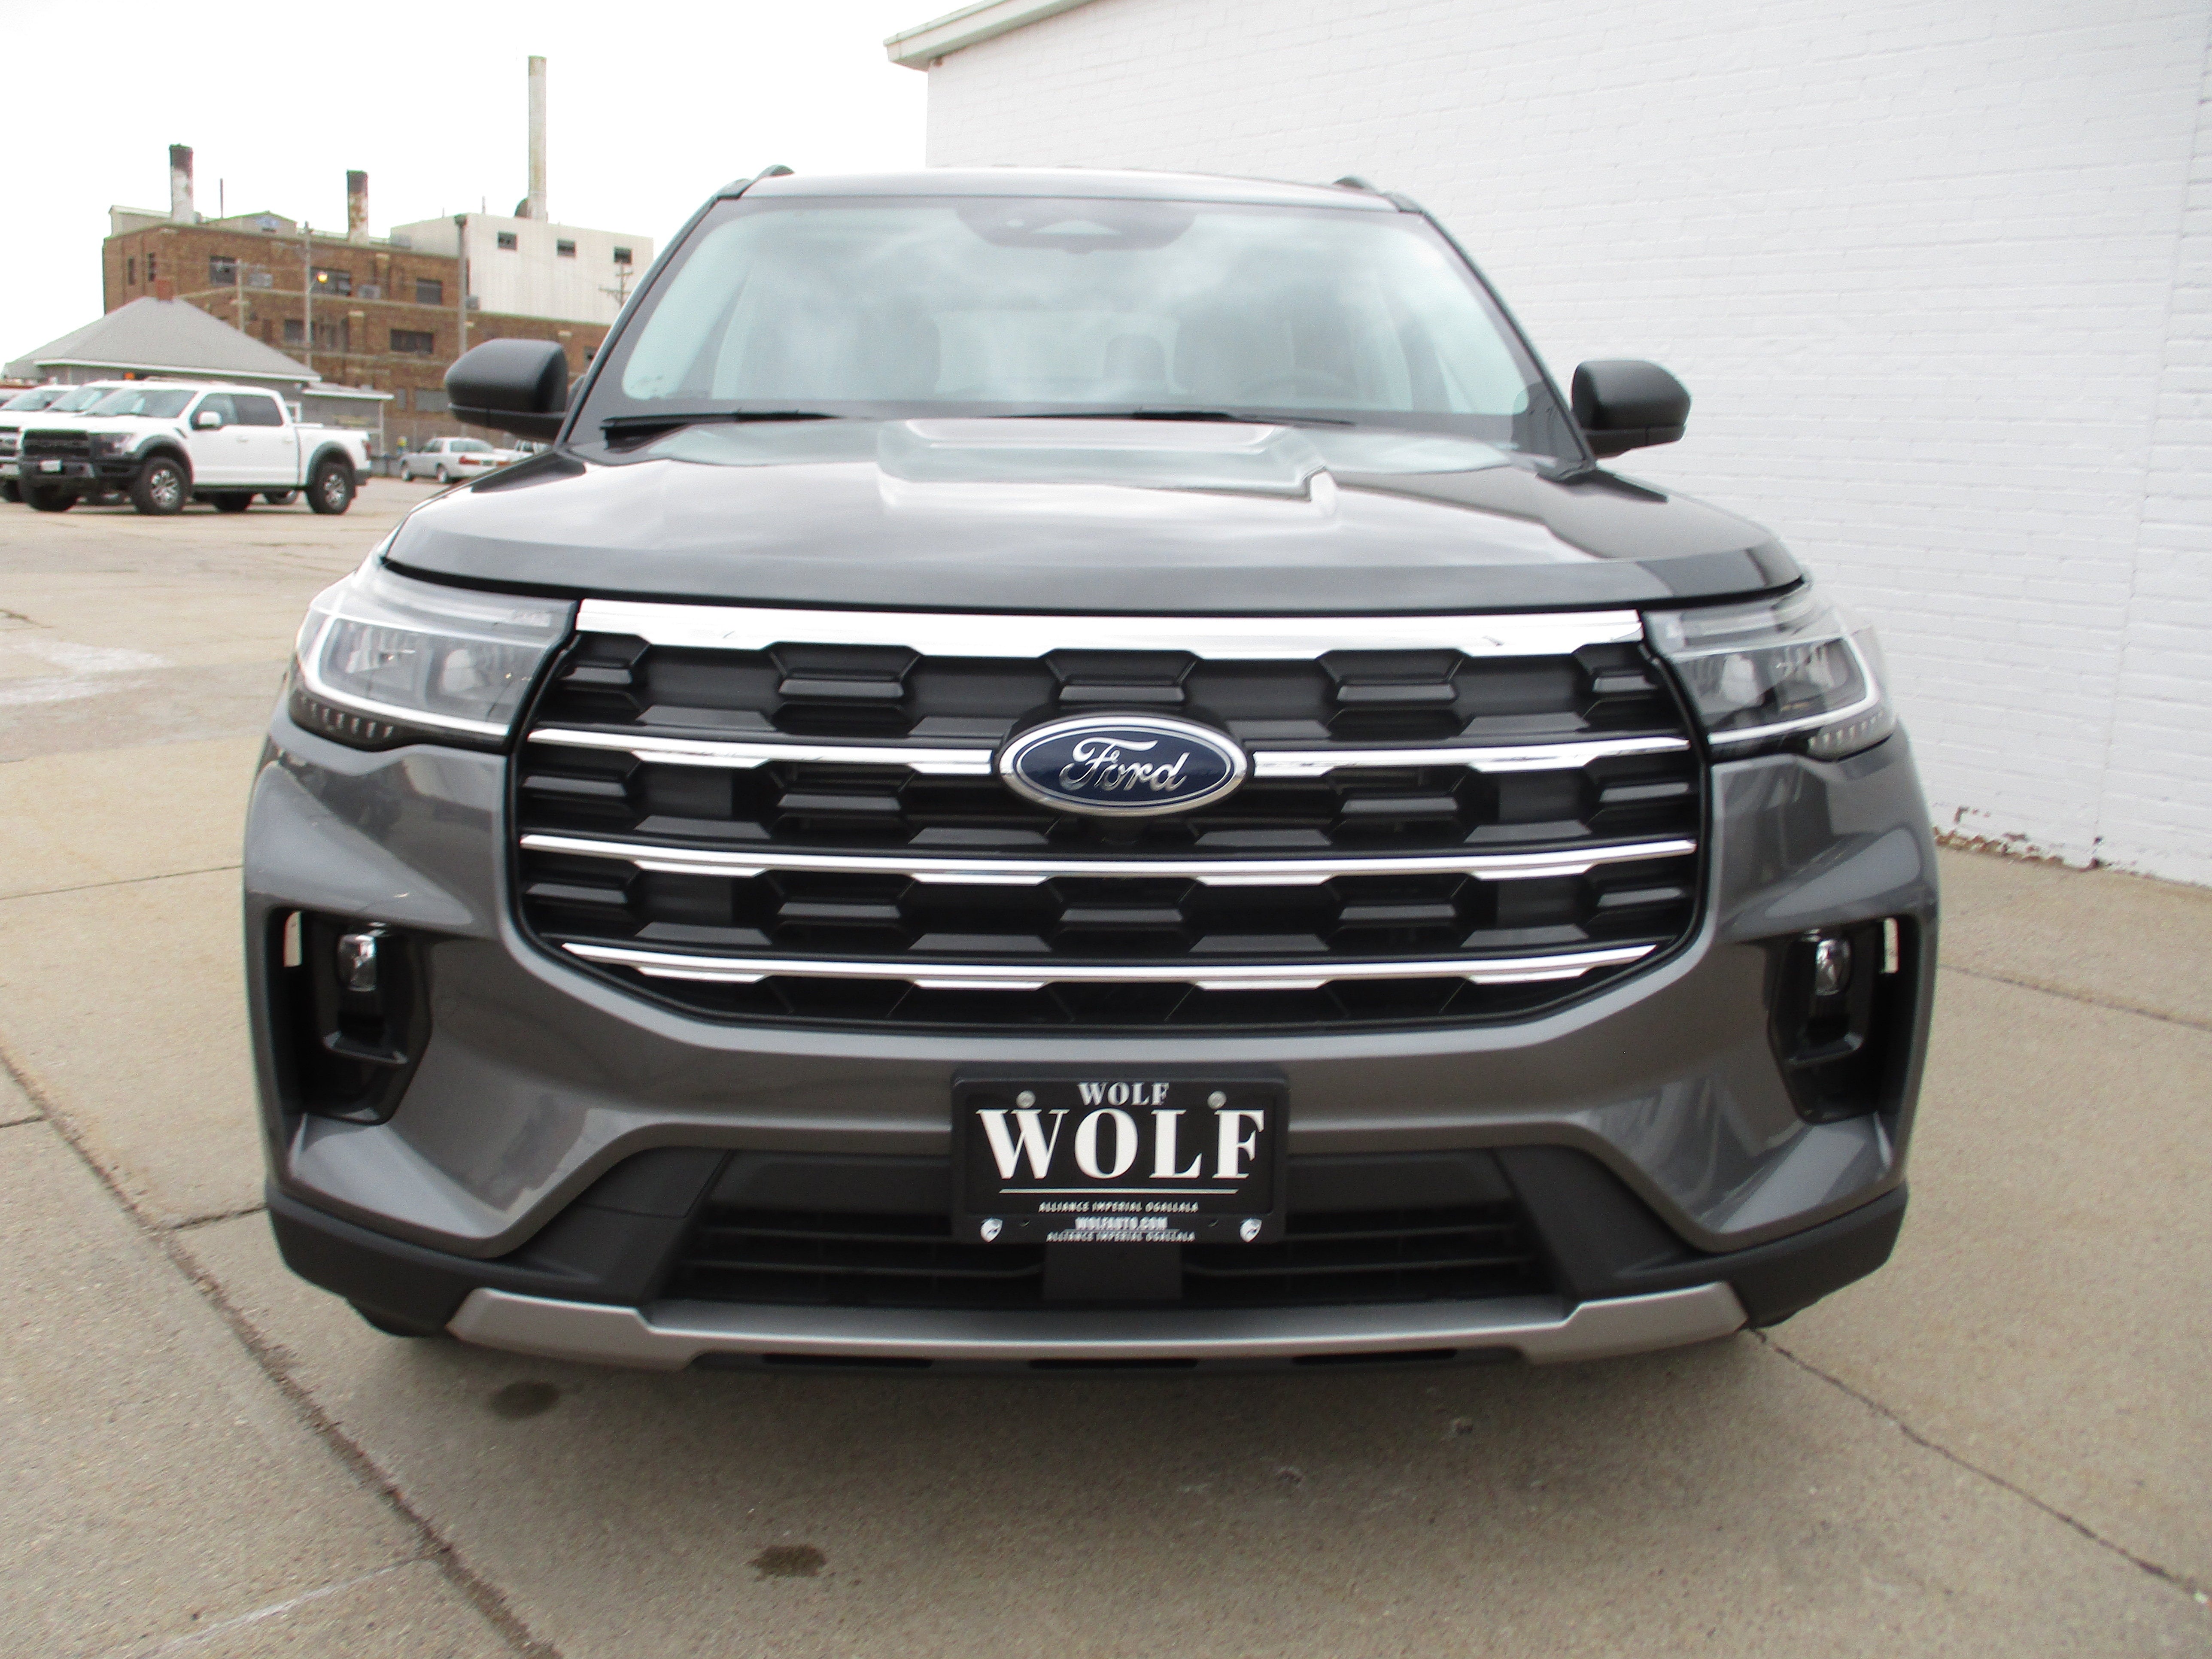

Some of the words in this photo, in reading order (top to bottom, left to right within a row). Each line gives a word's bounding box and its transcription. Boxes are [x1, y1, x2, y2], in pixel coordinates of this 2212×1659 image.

[1059, 737, 1190, 791] Ford
[1077, 1082, 1170, 1106] WOLF
[975, 1108, 1264, 1179] WOLF
[1038, 1202, 1090, 1213] ALLIANCE
[1092, 1202, 1142, 1213] IMPERIAL
[1145, 1202, 1199, 1213] OGALLALA
[1046, 1231, 1095, 1242] ALLIANCE
[1096, 1231, 1143, 1242] IMPERIAL
[1146, 1231, 1196, 1242] OGALLALA
